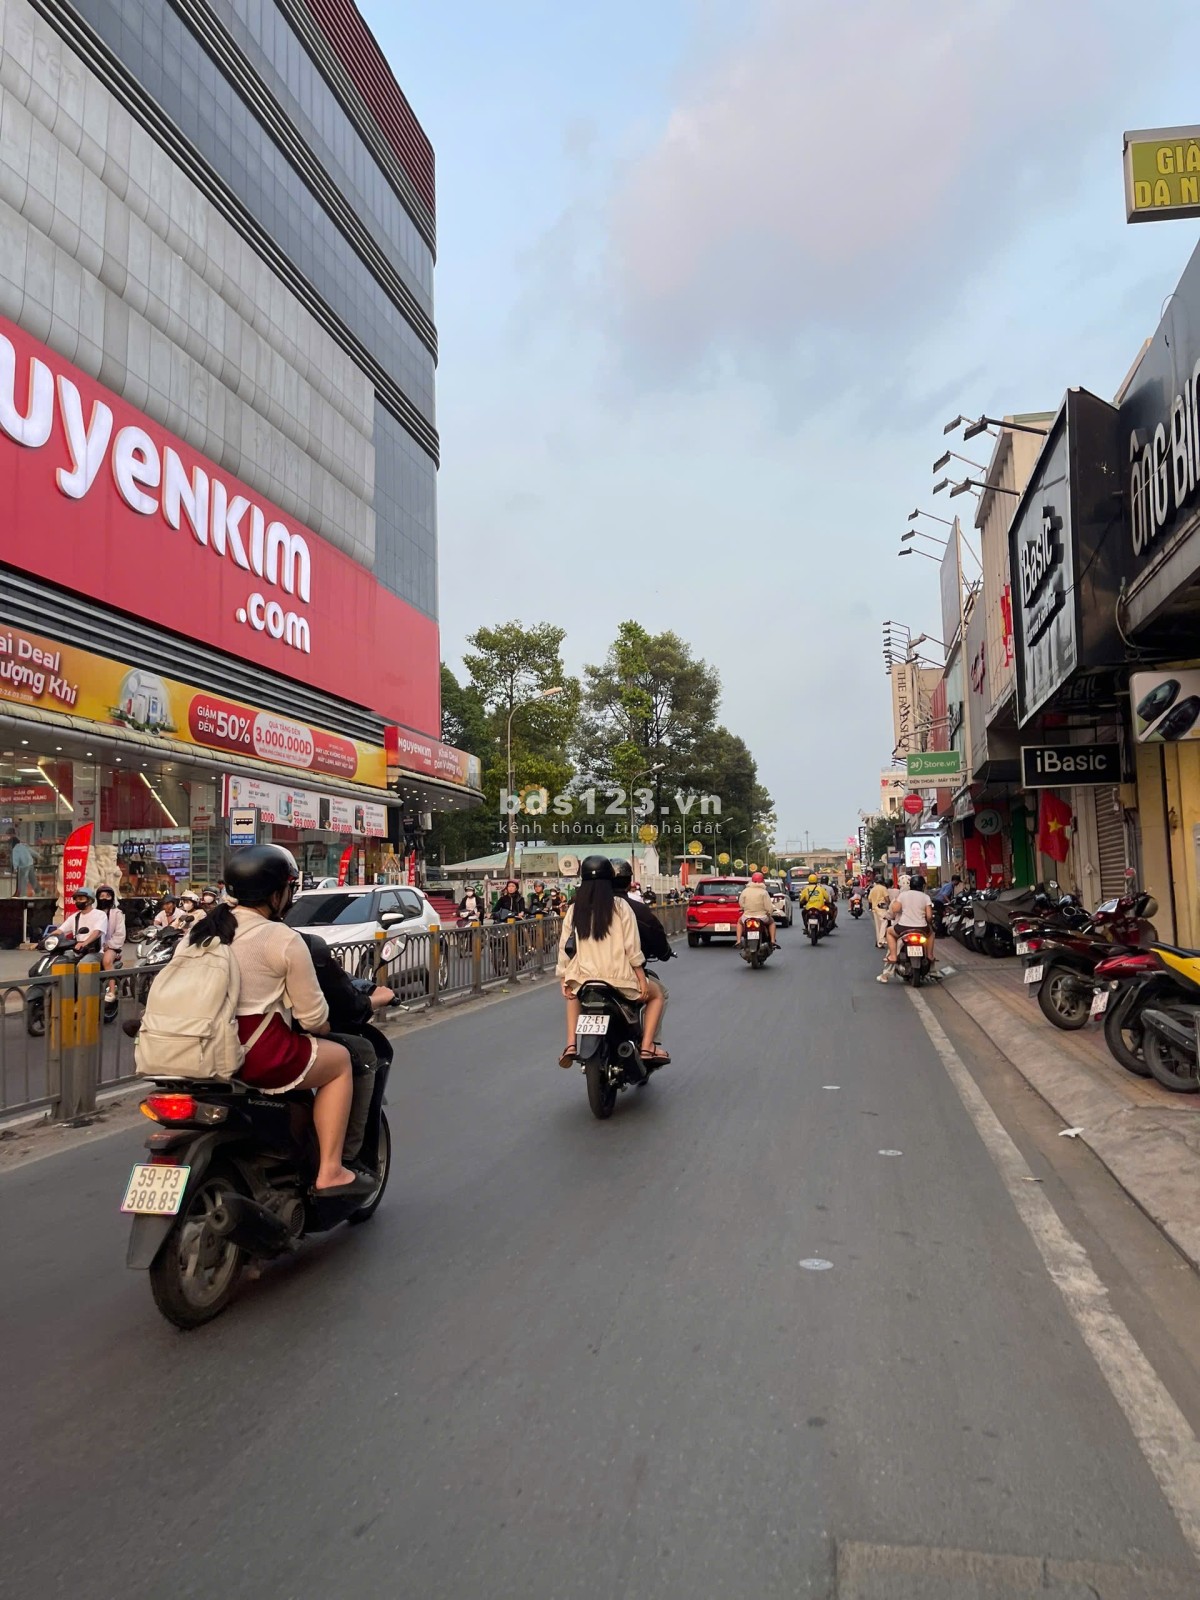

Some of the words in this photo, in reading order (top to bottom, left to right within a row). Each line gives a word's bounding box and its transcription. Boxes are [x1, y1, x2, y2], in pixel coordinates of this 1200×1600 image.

[1135, 179, 1171, 209] DA
[1180, 176, 1200, 204] N
[236, 592, 311, 655] .com
[18, 638, 61, 672] Deal
[48, 674, 78, 705] Khí
[897, 671, 907, 693] THE
[197, 705, 217, 720] GIẢM
[198, 717, 214, 733] ĐẾN
[216, 711, 251, 744] 50%
[924, 760, 956, 769] Store.vn
[1036, 749, 1107, 773] iBasic
[138, 1168, 181, 1189] 59-P3
[127, 1189, 180, 1211] 388.85
